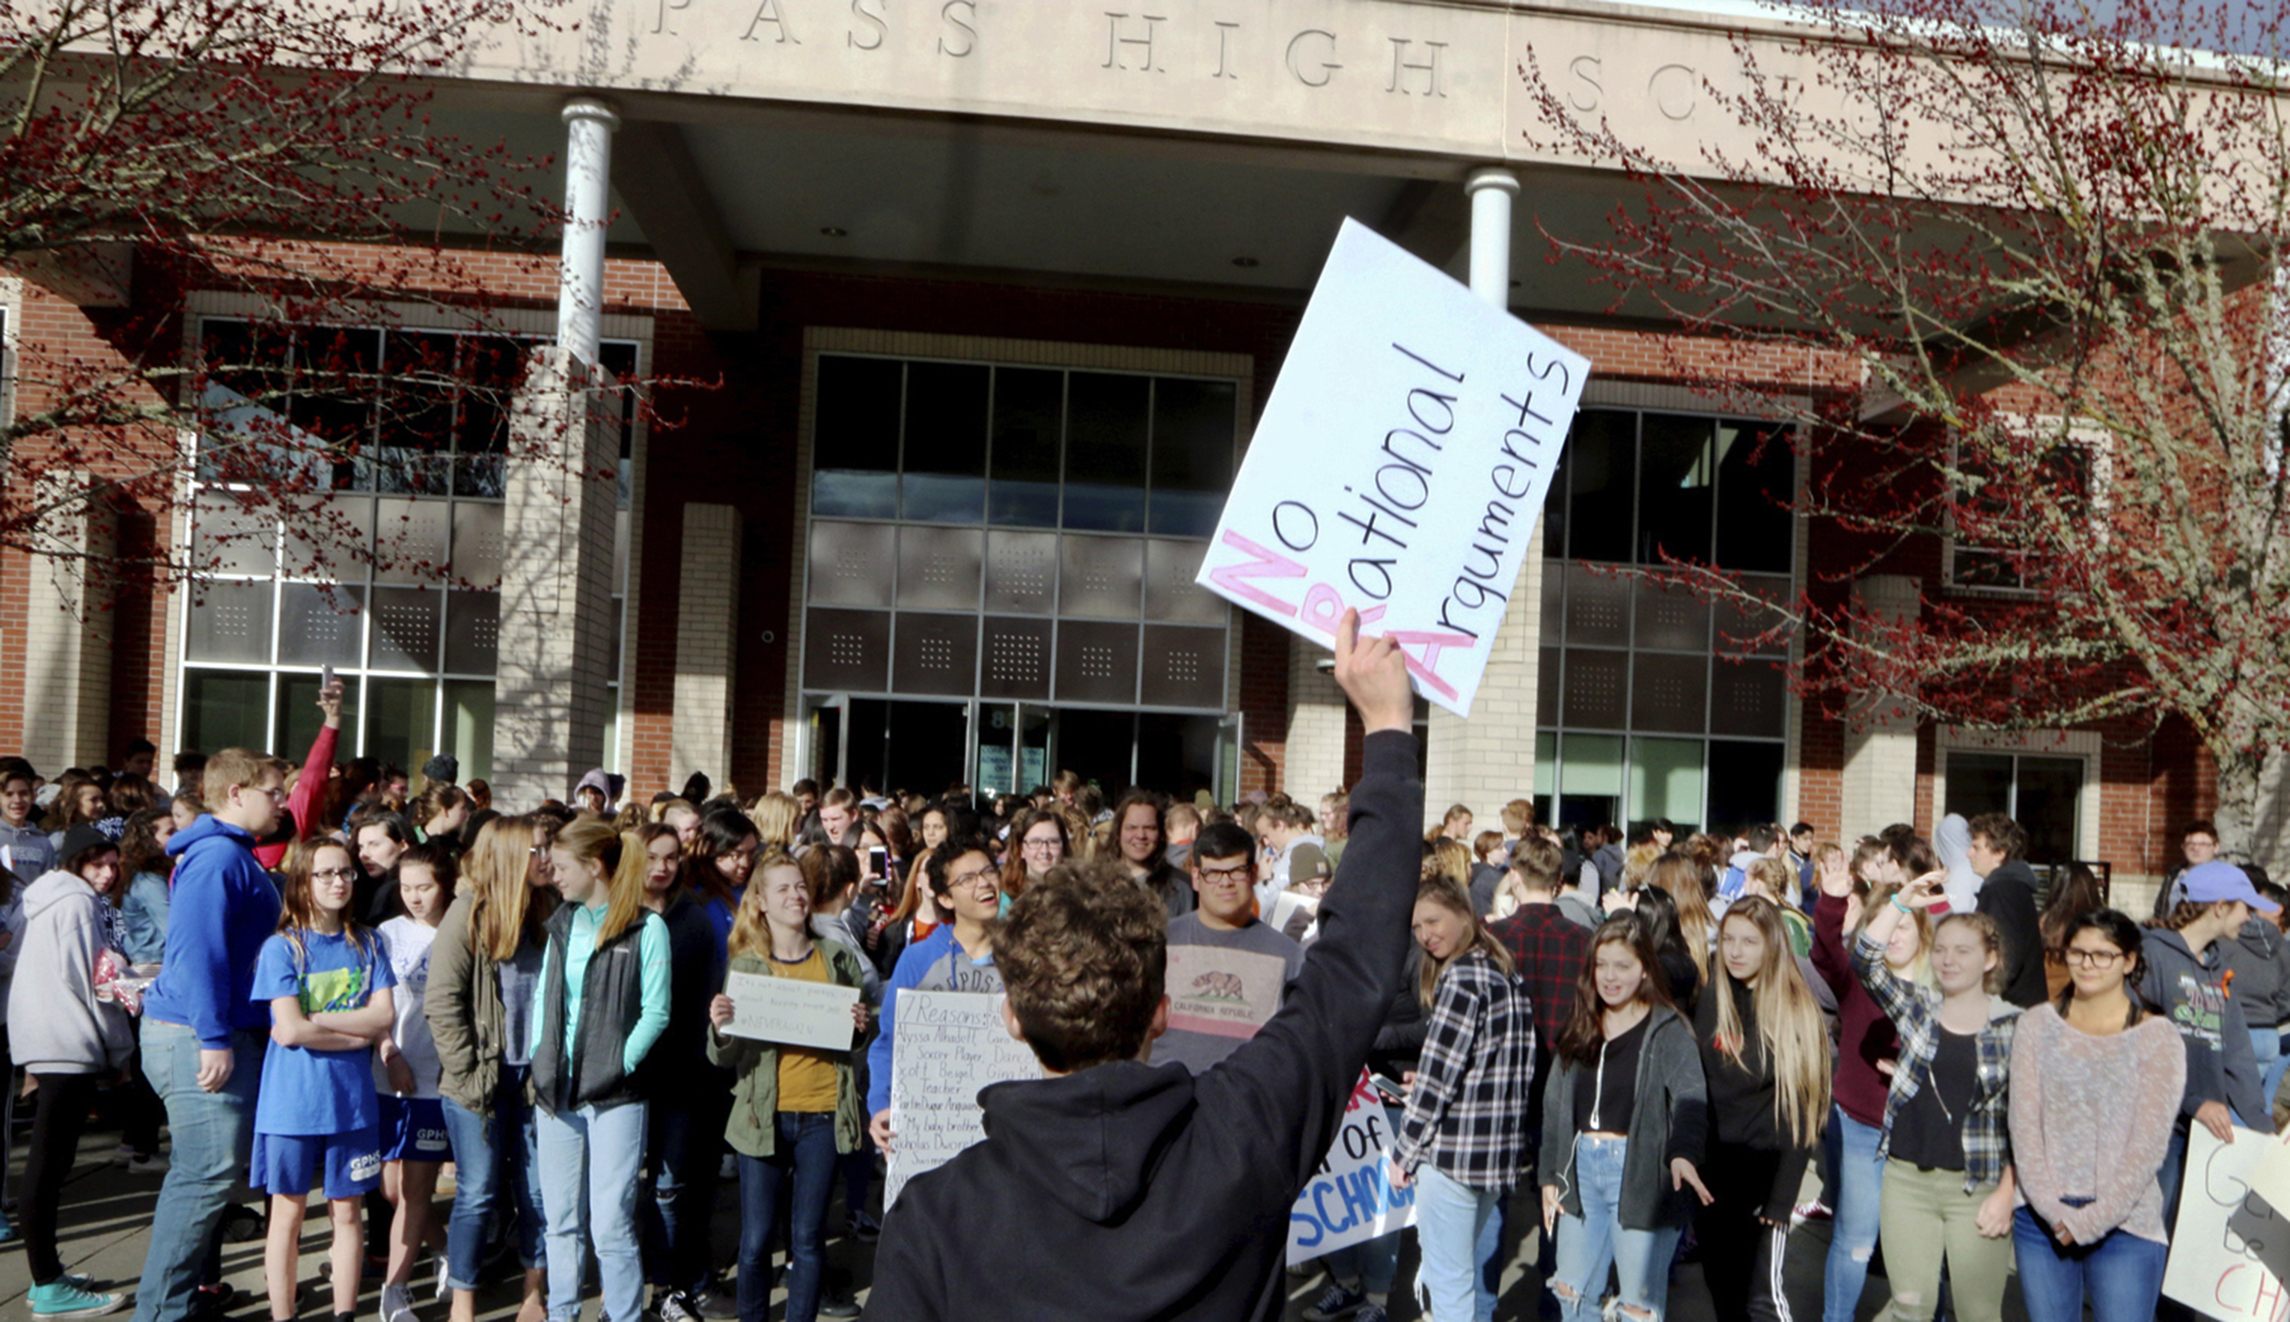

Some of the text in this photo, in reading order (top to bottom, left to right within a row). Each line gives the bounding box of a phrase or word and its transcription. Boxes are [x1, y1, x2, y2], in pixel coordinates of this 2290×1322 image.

[650, 0, 978, 58] PASS
[1102, 12, 1450, 100] HIGH
[1383, 351, 1570, 704] Arguments
[1208, 500, 1319, 618] No
[917, 993, 987, 1027] Reasons:
[1173, 1000, 1255, 1020] CALIFORNIA REPUBLIC
[895, 1027, 930, 1049] Alyssa
[917, 1045, 949, 1062] Soccer
[895, 1061, 928, 1080] Scott
[2215, 1262, 2290, 1322] CH
